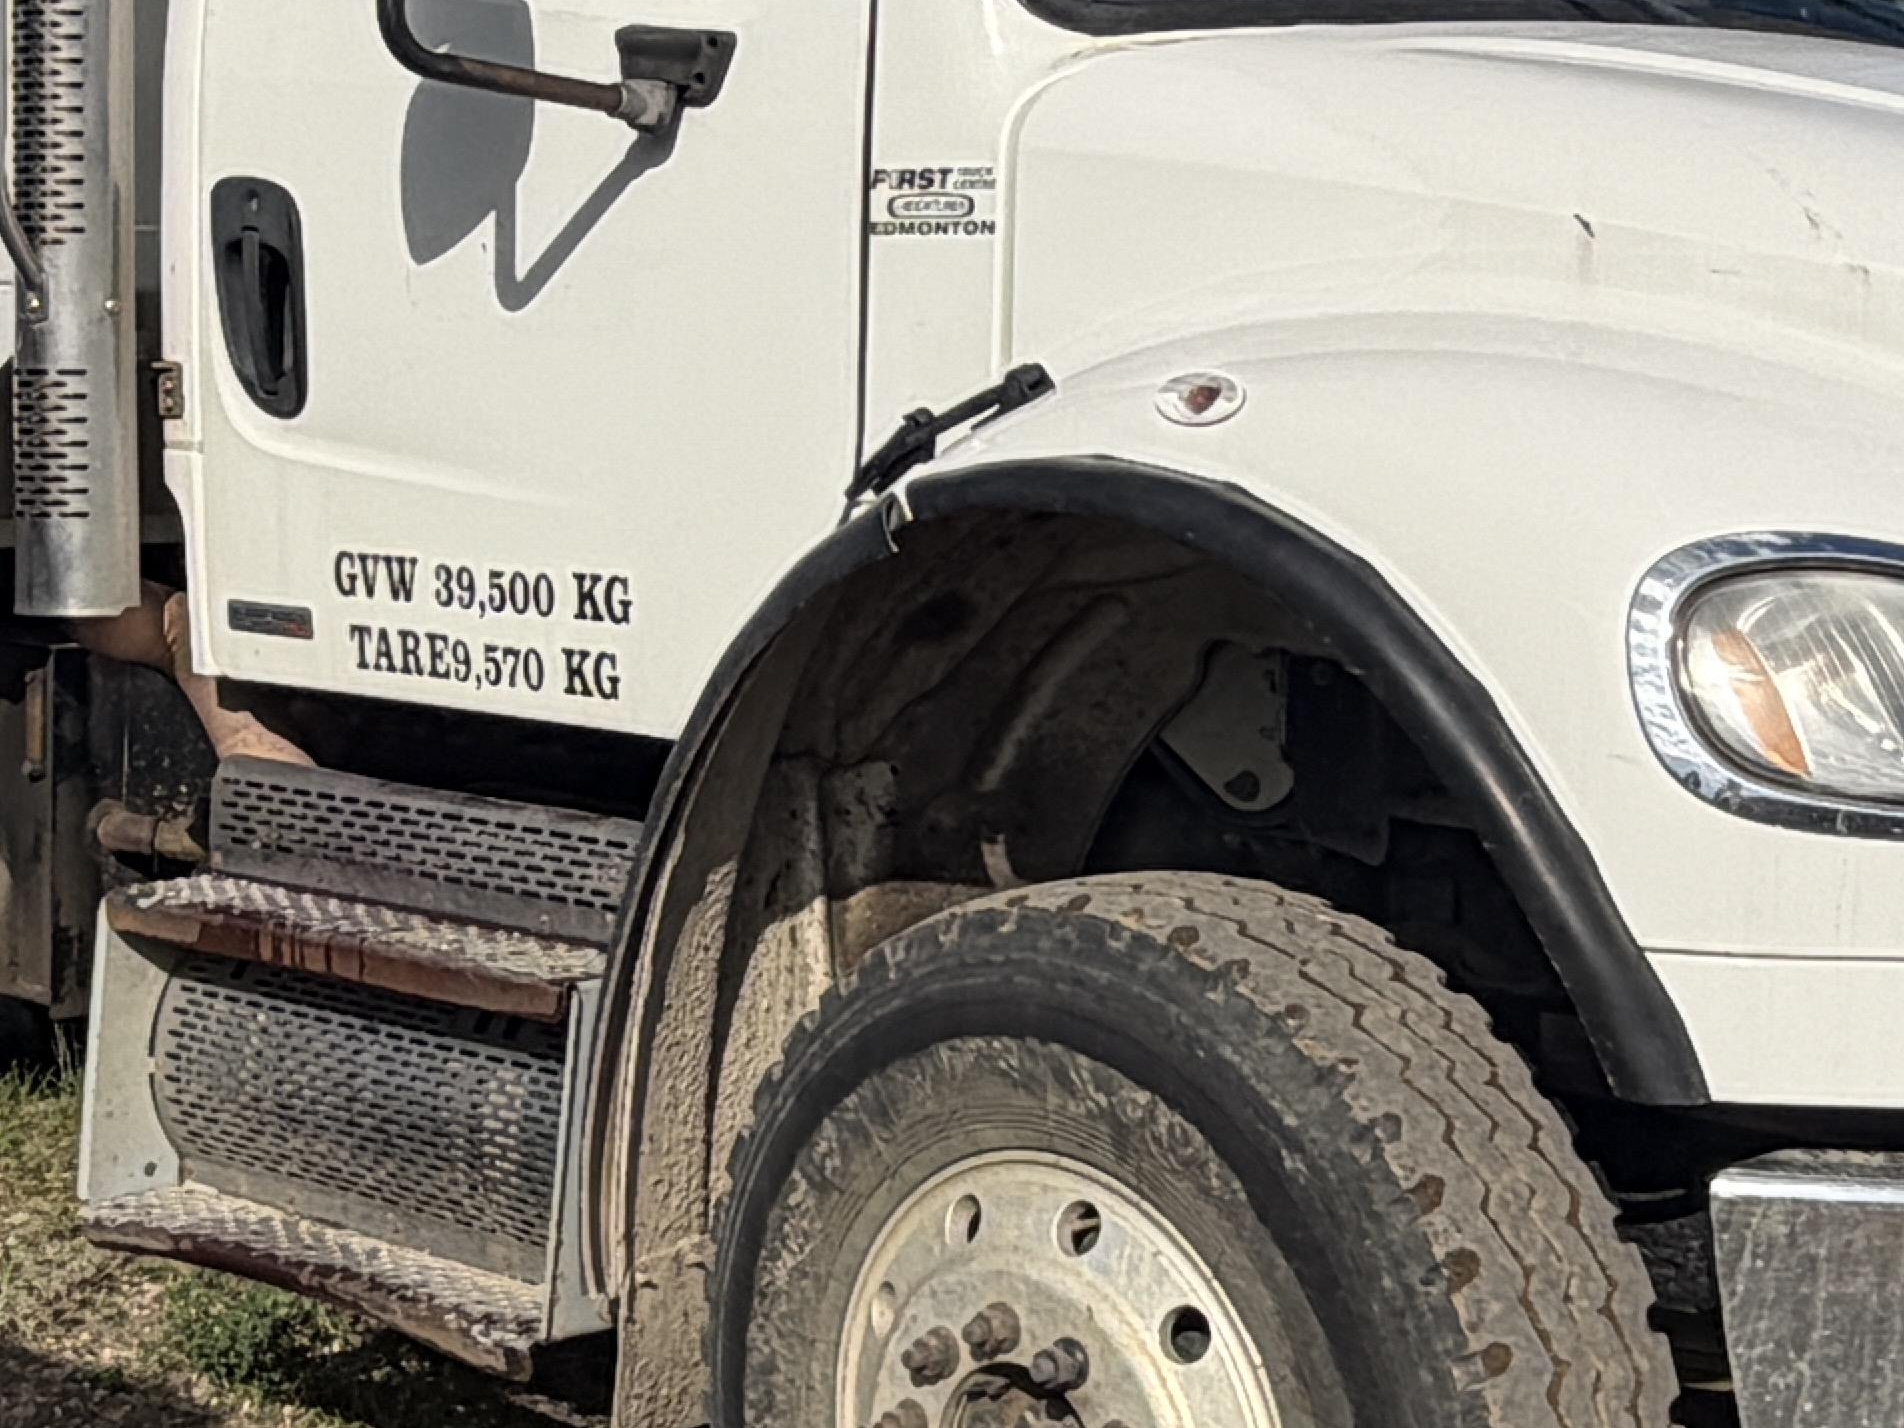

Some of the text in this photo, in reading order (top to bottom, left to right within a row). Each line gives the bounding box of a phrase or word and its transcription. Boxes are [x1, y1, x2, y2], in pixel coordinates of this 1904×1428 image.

[872, 168, 953, 189] FIRST
[870, 221, 995, 235] EDMONTON
[335, 551, 632, 624] GVW 39,500 KG
[561, 648, 620, 699] KG
